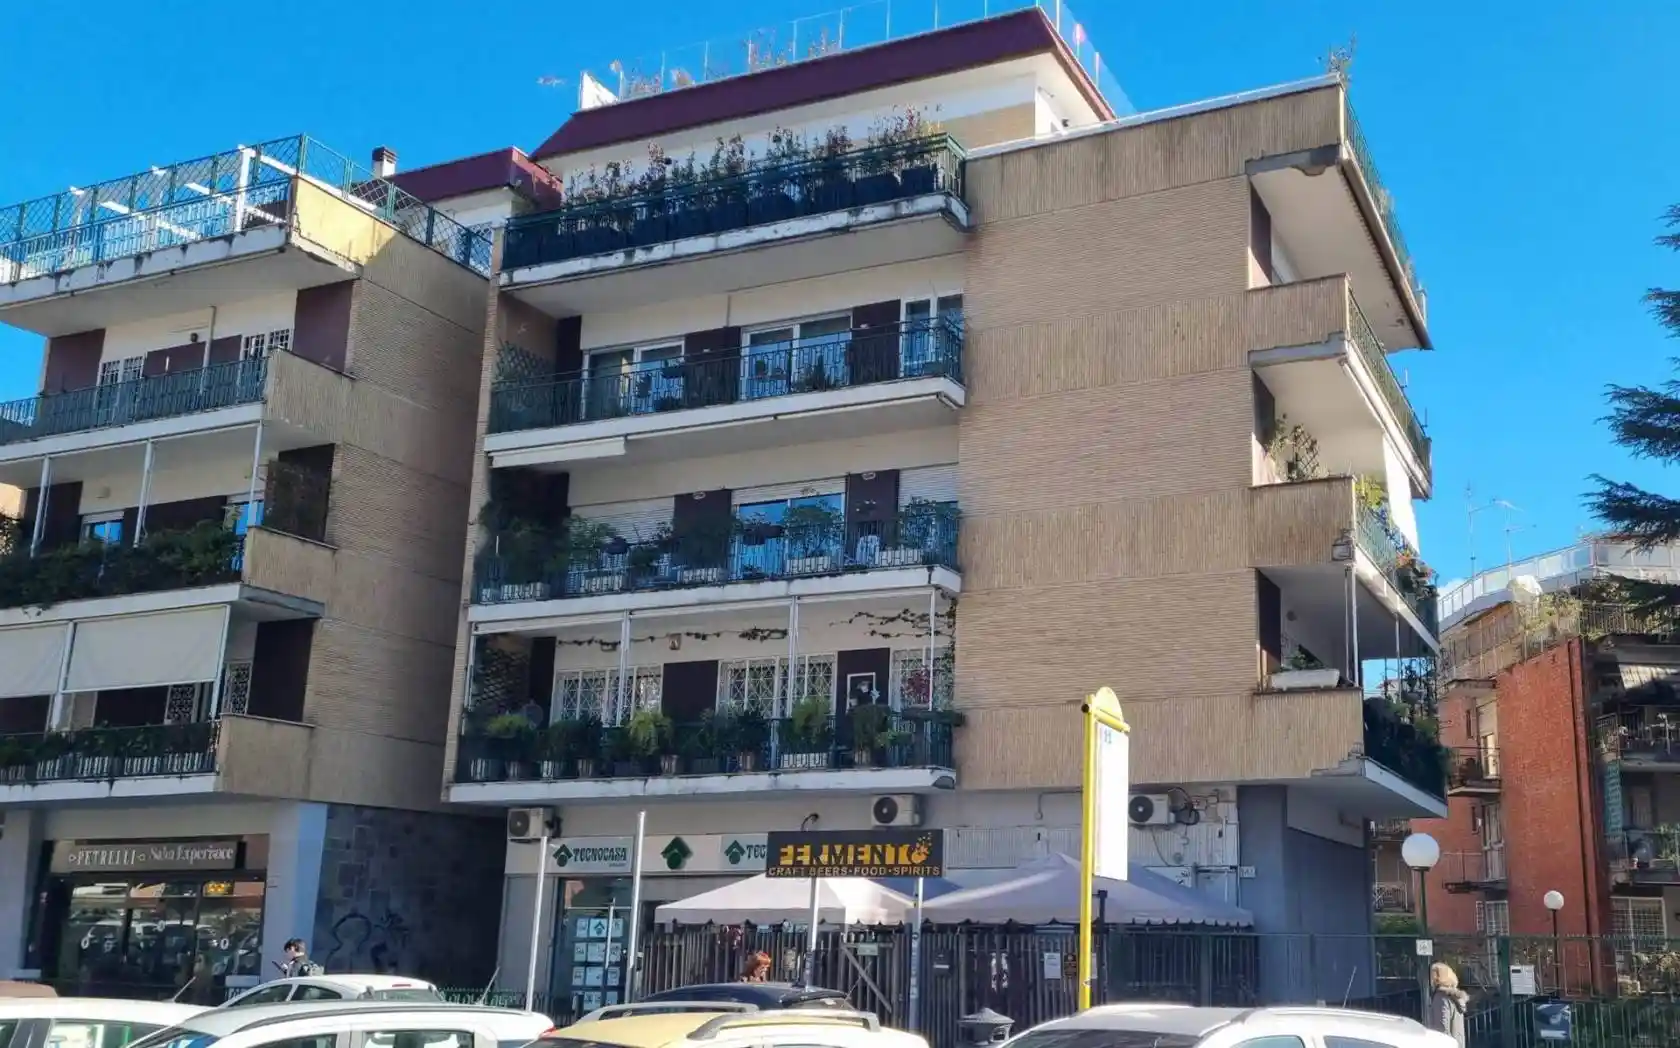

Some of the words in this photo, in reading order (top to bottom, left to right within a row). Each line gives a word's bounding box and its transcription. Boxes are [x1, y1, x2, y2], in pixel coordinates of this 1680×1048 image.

[77, 849, 136, 866] PETRELLI
[176, 844, 234, 865] Experience
[573, 847, 627, 862] TECNOCASA
[777, 843, 930, 866] FERMENTO
[768, 866, 804, 877] CRAFT
